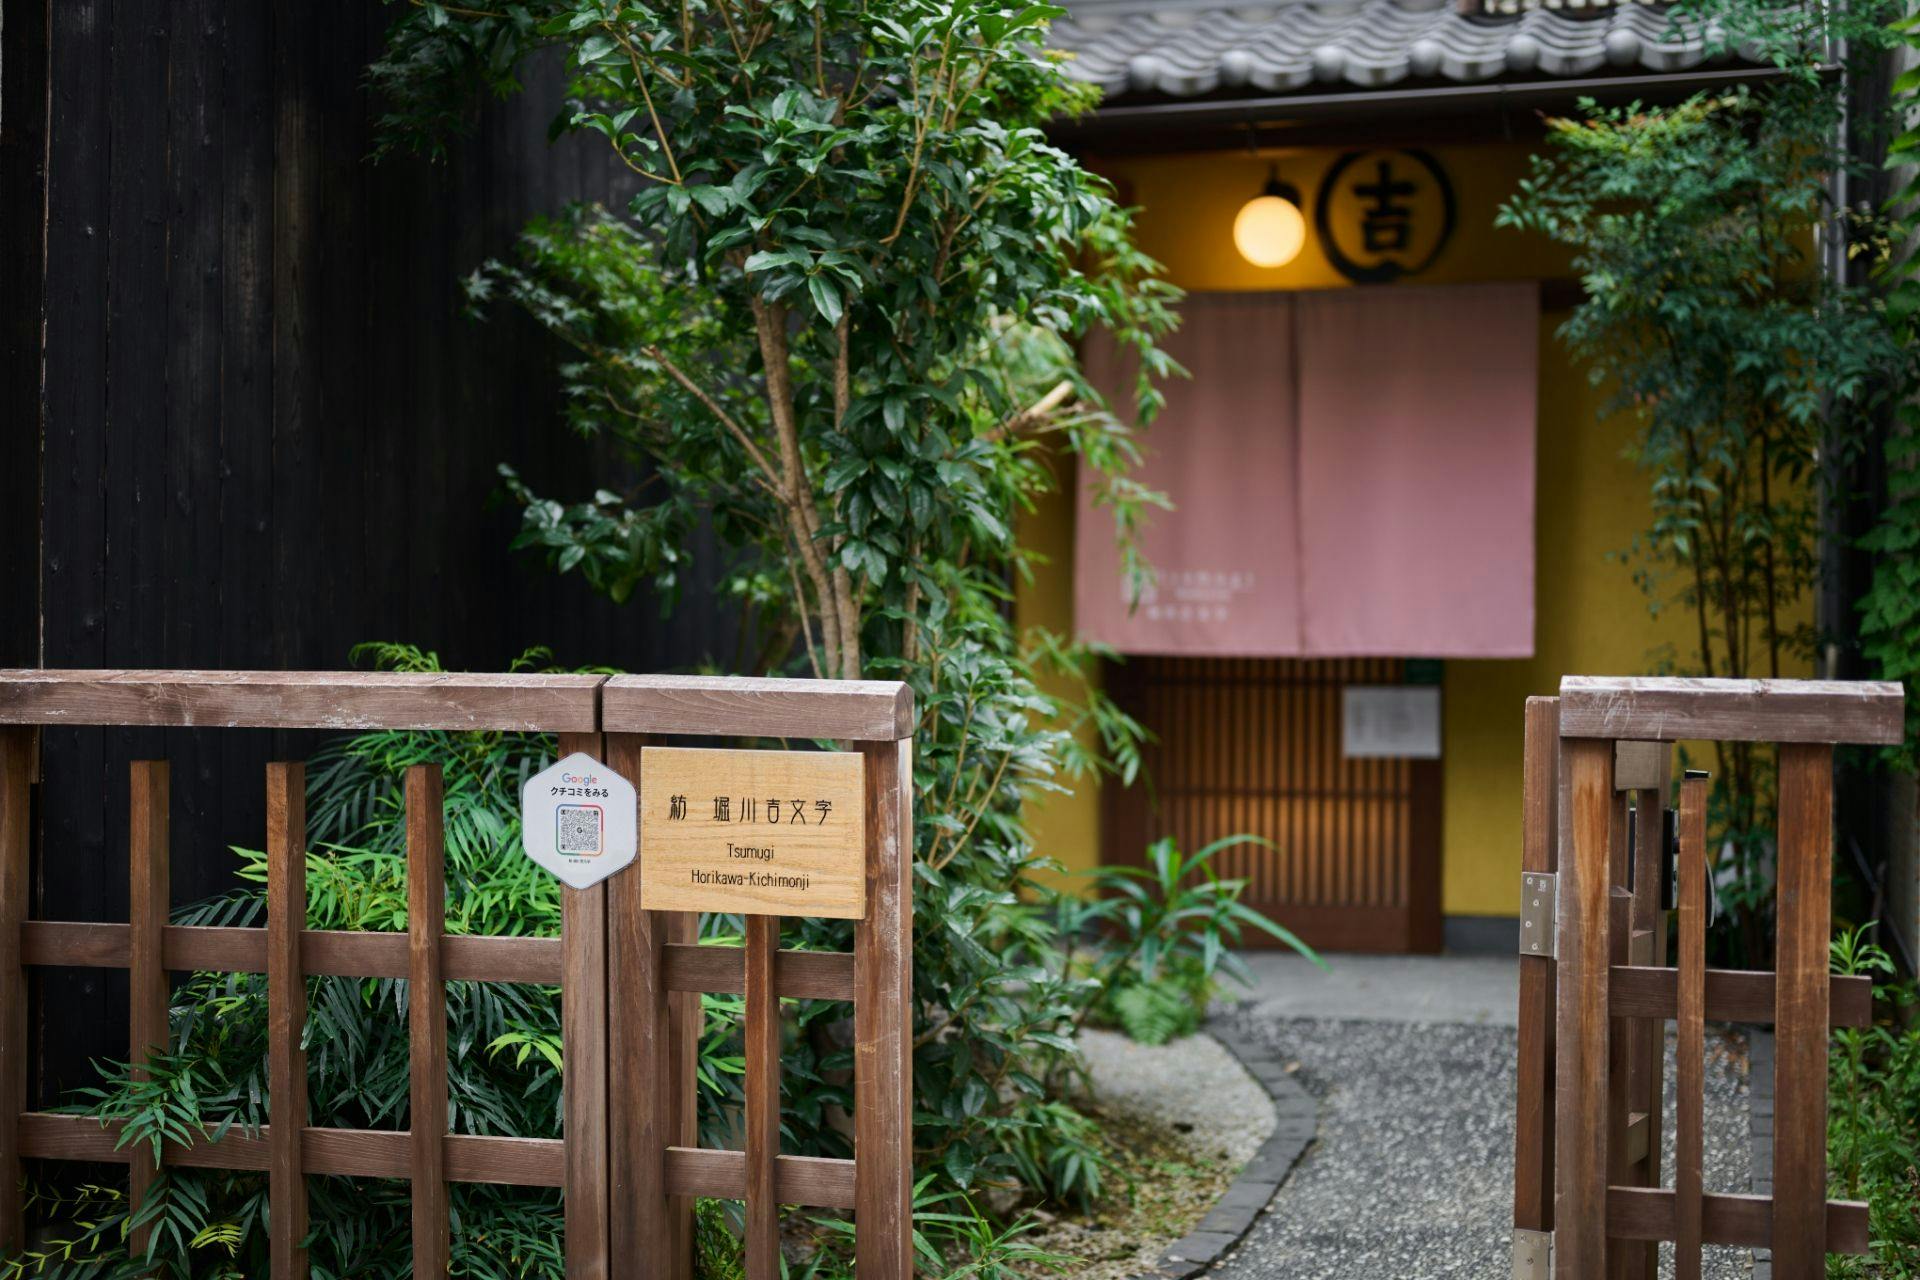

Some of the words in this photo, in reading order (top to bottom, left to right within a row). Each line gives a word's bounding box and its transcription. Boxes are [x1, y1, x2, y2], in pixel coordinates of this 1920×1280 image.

[1353, 160, 1417, 254] 吉
[562, 772, 597, 786] Google
[550, 786, 609, 798] クチコミをみる
[713, 796, 833, 826] 堀川吉文字
[727, 843, 775, 861] Tsumugi
[691, 869, 810, 891] Horikawa-Kichimonji
